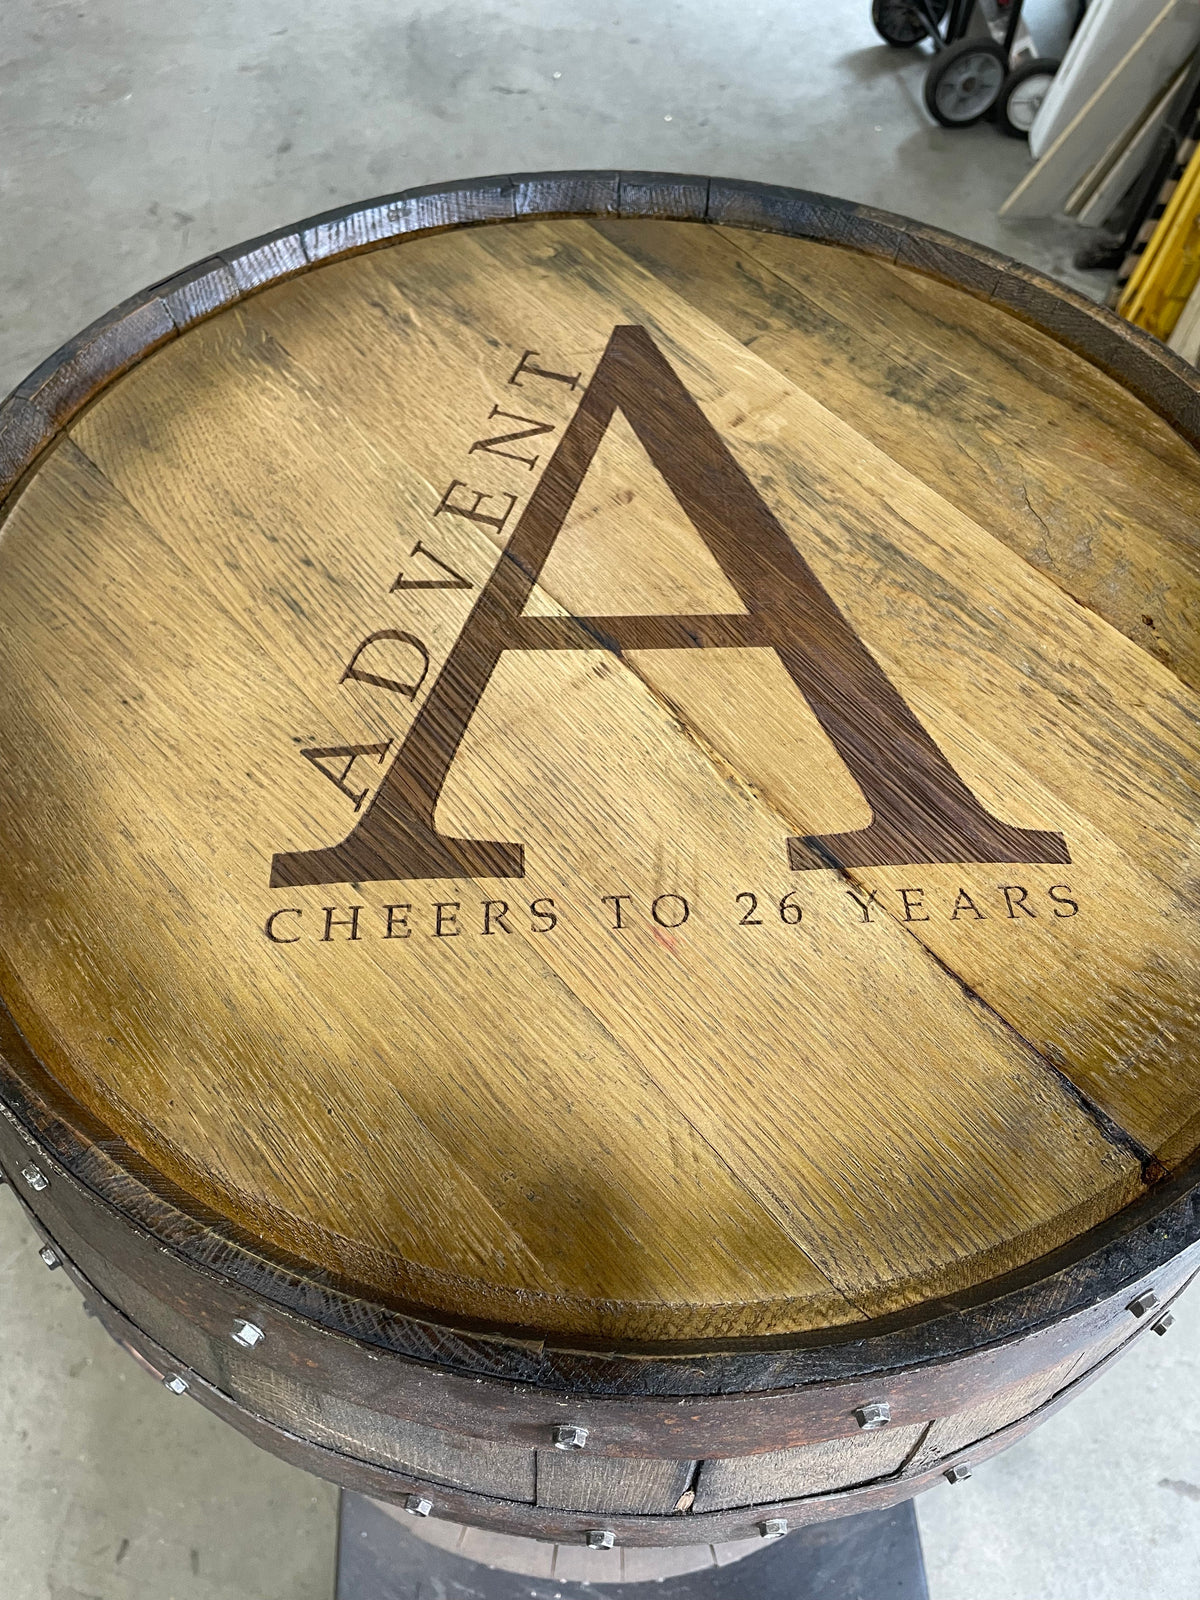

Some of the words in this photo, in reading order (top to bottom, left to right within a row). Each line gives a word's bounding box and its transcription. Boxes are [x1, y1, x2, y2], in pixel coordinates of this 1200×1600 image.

[269, 325, 1072, 888] A
[300, 350, 582, 812] ADVENT
[264, 897, 558, 944] CHEERS
[601, 894, 691, 929] TO
[735, 891, 804, 926] 26
[845, 884, 1080, 924] YEARS
